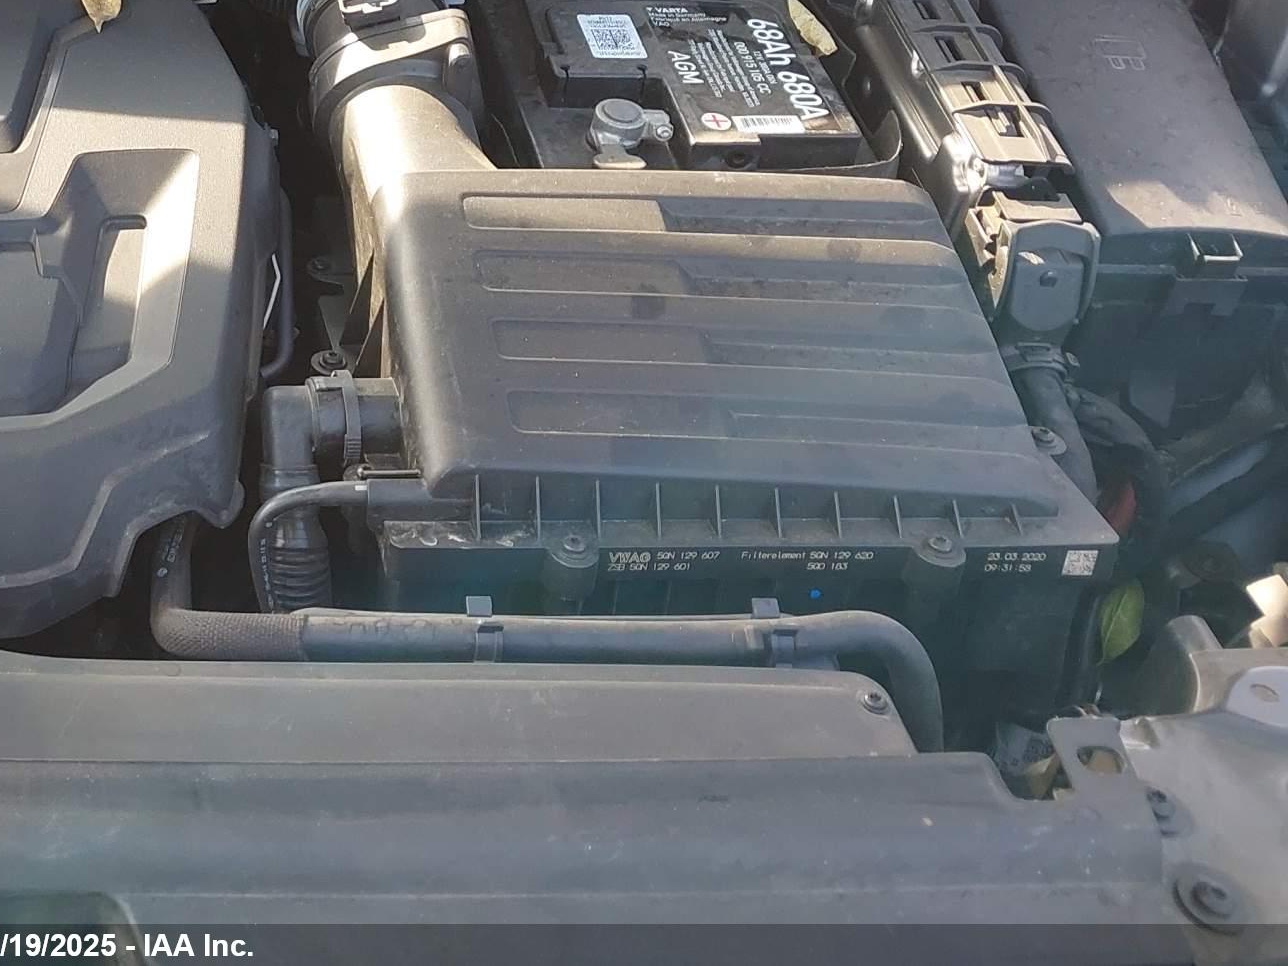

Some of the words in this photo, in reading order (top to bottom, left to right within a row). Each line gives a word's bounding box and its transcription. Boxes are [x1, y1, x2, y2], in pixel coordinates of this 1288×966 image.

[733, 41, 749, 54] 000
[741, 54, 758, 68] 915
[667, 50, 705, 84] AGM
[747, 19, 796, 66] 68Ah
[777, 70, 830, 121] 680A
[608, 551, 651, 563] VWAG
[681, 551, 698, 560] 129
[701, 551, 721, 560] 607
[740, 551, 806, 560] Filterelement
[834, 551, 852, 560] 129
[987, 552, 1047, 561] 23.03.2020
[653, 562, 670, 571] 129
[674, 562, 690, 571] 601
[984, 563, 1032, 572] 09:31:58
